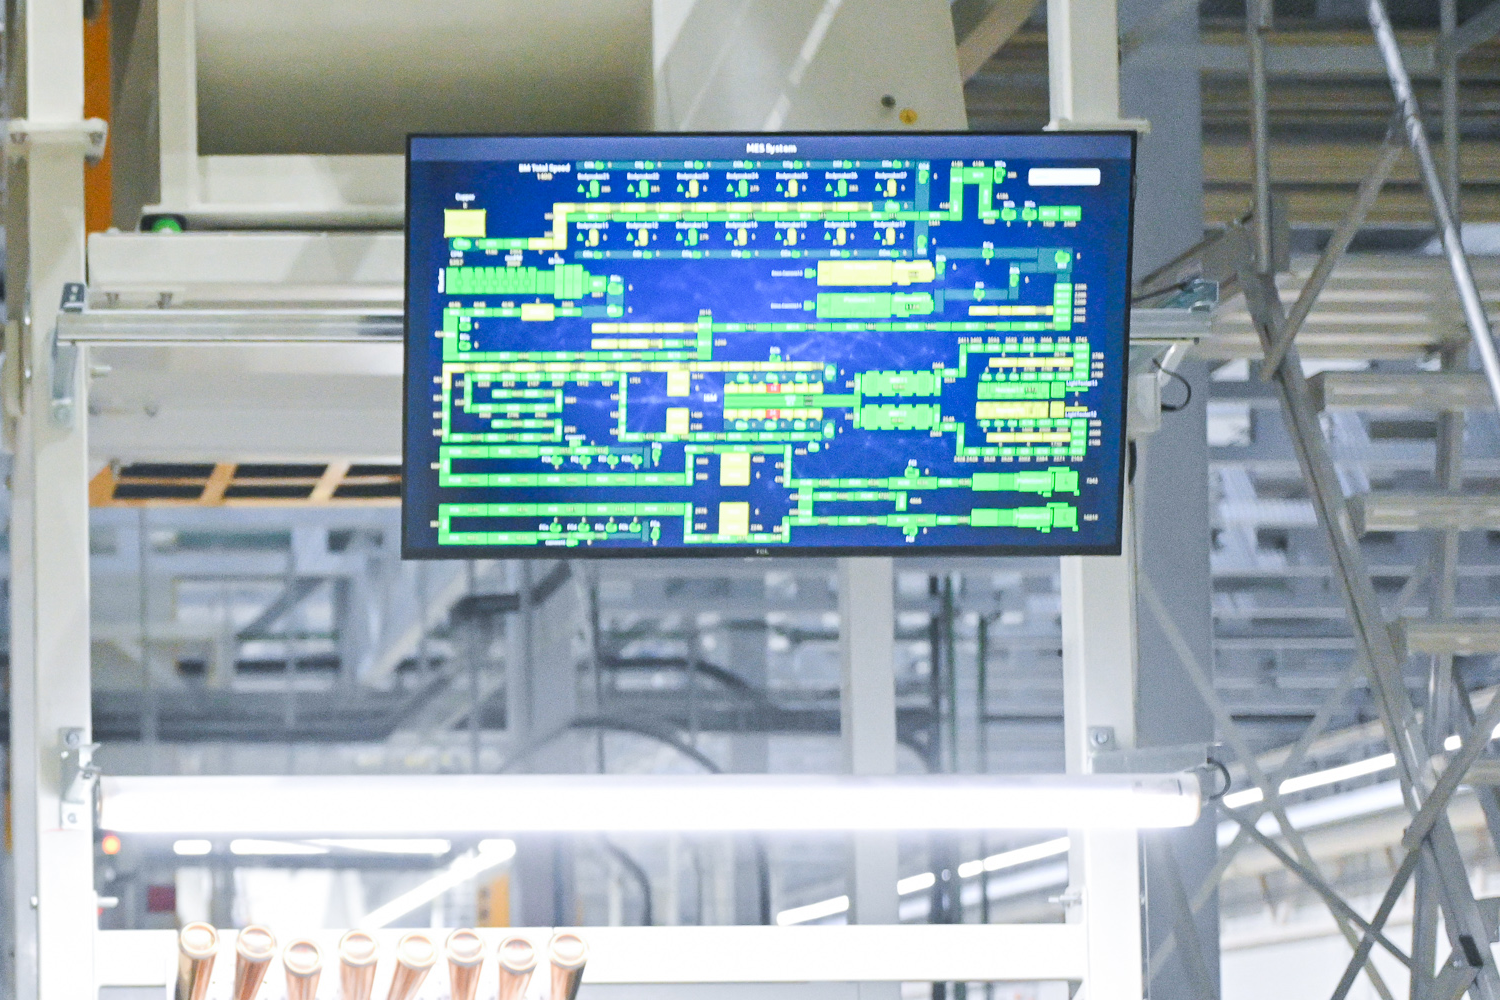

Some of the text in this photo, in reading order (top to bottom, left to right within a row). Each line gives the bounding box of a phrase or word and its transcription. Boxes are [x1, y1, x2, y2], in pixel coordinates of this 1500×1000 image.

[746, 143, 797, 155] MES System
[532, 162, 548, 173] Total
[549, 162, 571, 174] Speed
